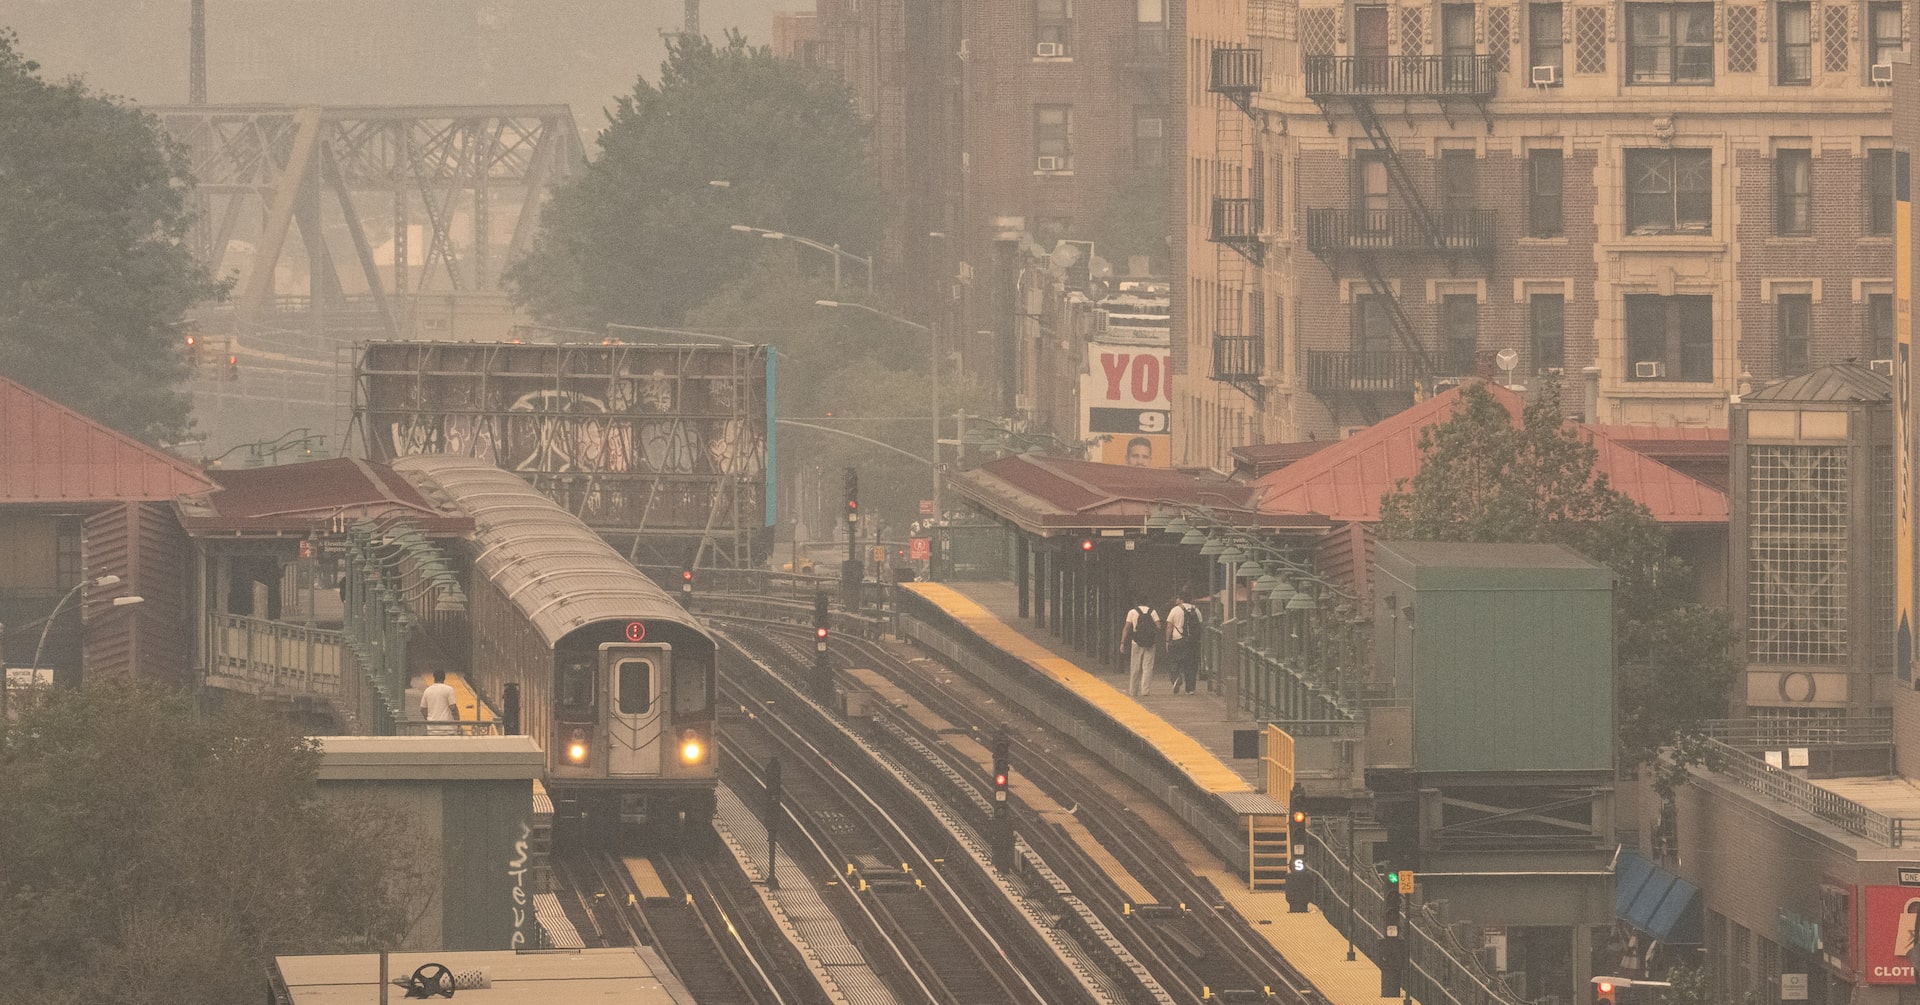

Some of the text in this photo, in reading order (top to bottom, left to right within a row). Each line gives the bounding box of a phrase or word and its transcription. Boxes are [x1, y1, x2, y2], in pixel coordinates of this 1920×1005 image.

[1139, 411, 1171, 433] 9
[1294, 859, 1304, 871] S
[1904, 873, 1919, 882] ONE
[1401, 882, 1412, 890] 25
